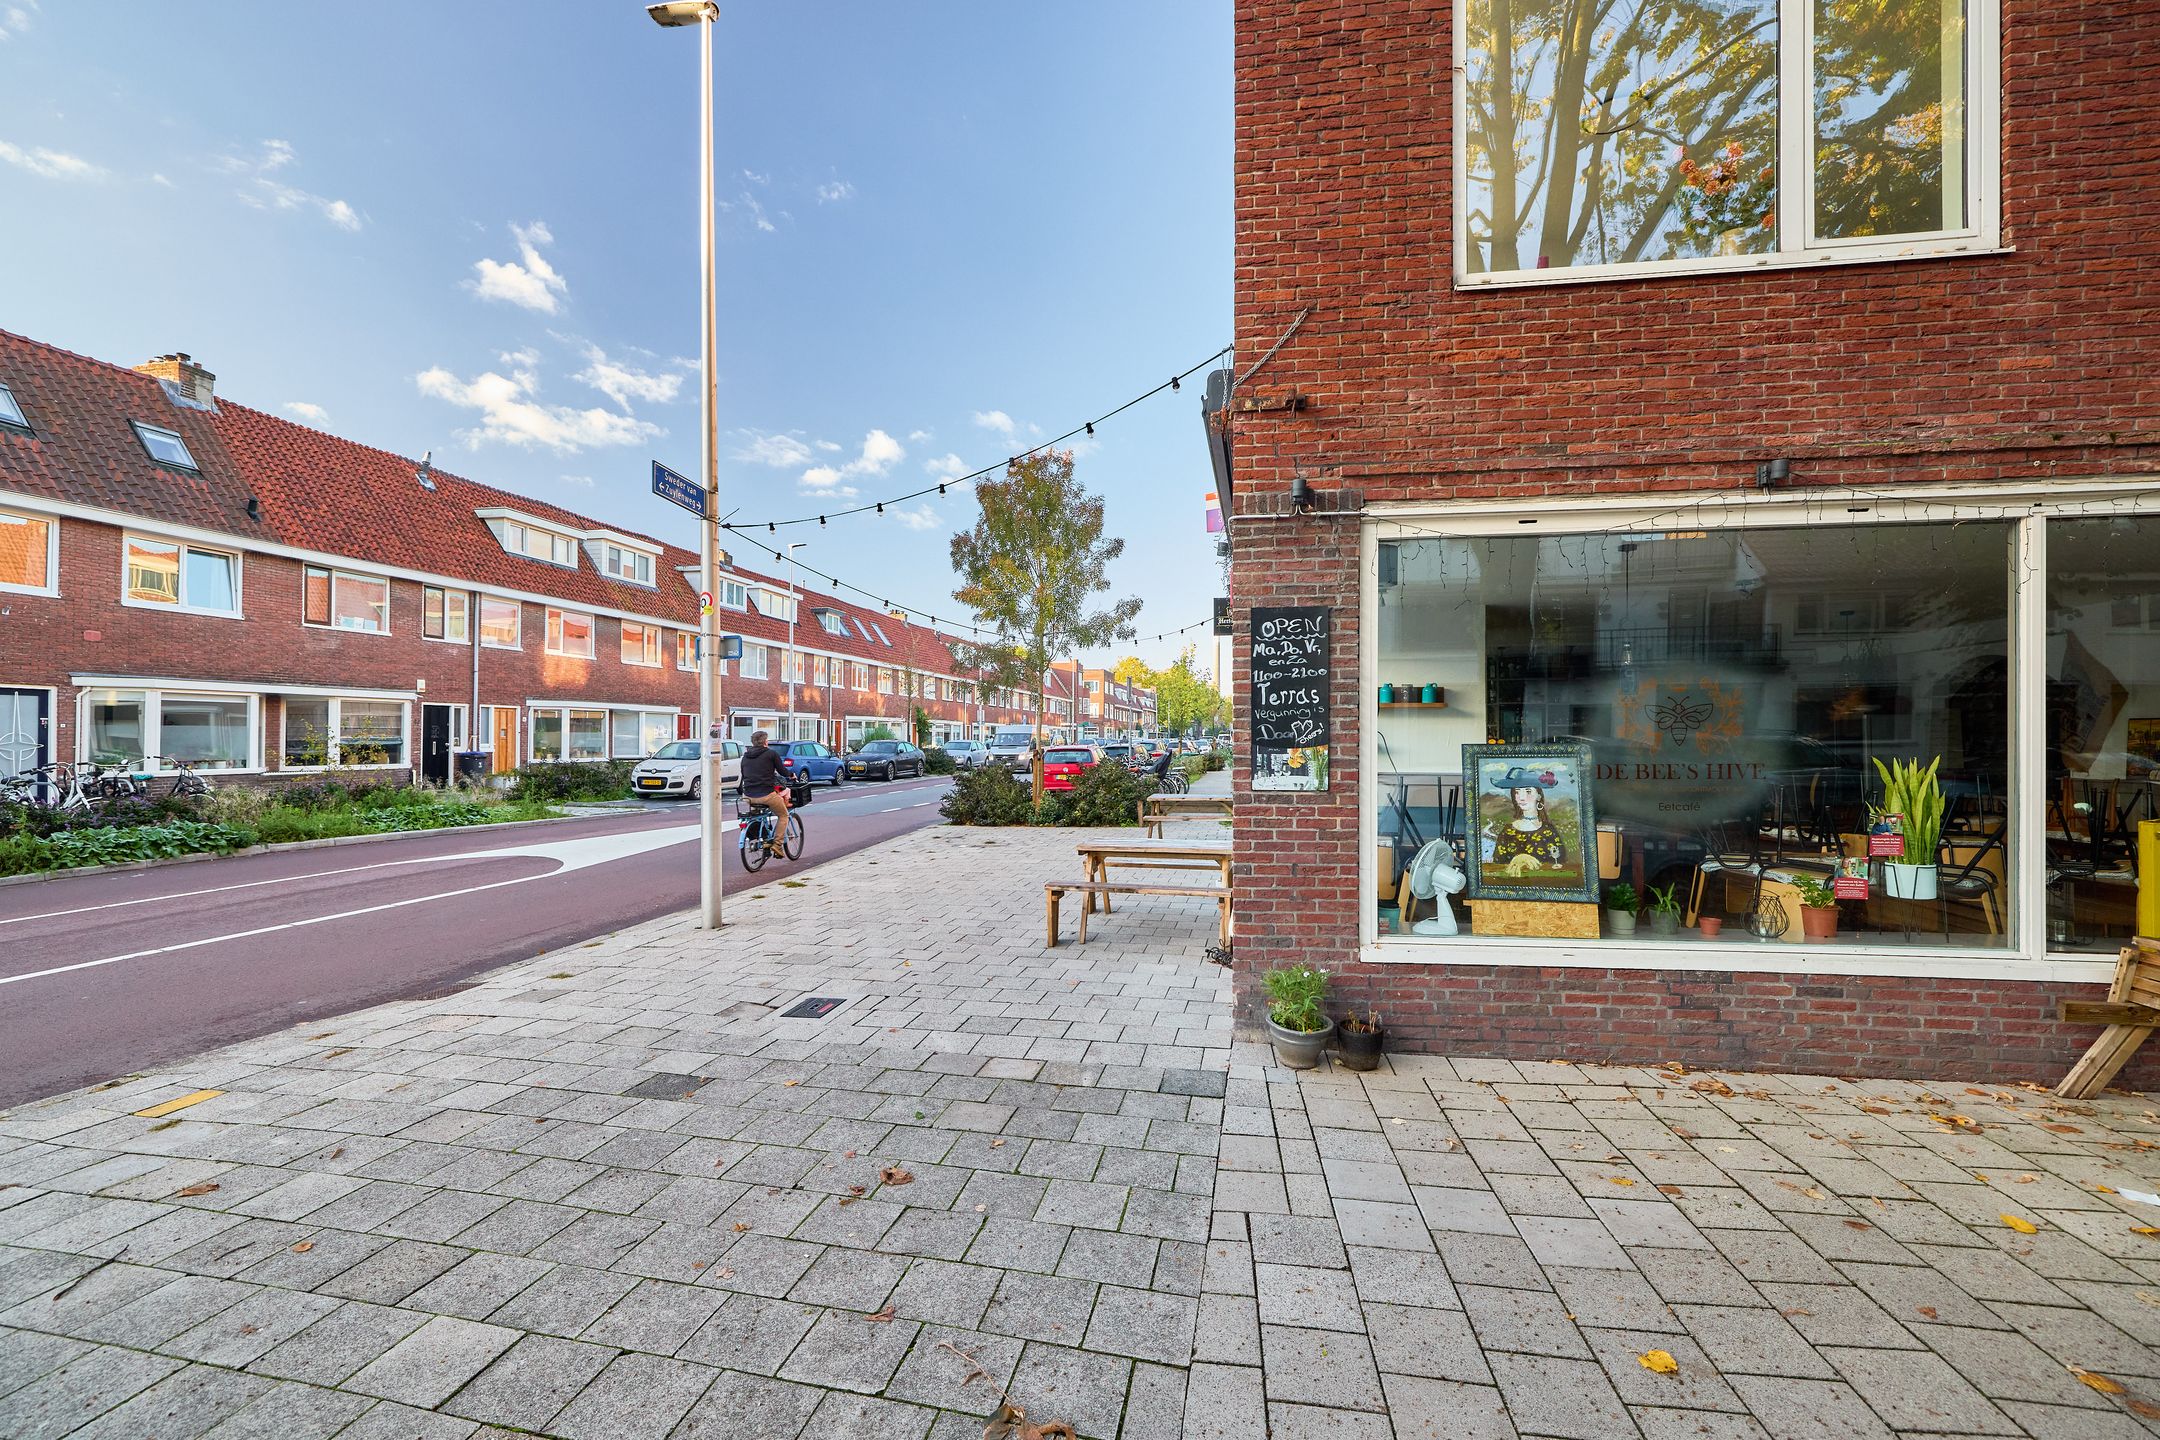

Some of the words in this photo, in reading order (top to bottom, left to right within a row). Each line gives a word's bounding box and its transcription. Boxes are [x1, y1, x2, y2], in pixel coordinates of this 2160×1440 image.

[664, 471, 686, 490] Sweder
[687, 485, 697, 497] van
[665, 484, 696, 509] Zuylenweg
[1261, 615, 1322, 638] OPEN
[1286, 655, 1308, 665] Za
[1257, 682, 1320, 705] Terras
[1256, 723, 1294, 740] Door
[1596, 763, 1628, 780] DE
[1634, 763, 1699, 780] BEE'S
[1706, 763, 1767, 780] HIVE
[1658, 801, 1700, 812] Eetcafé
